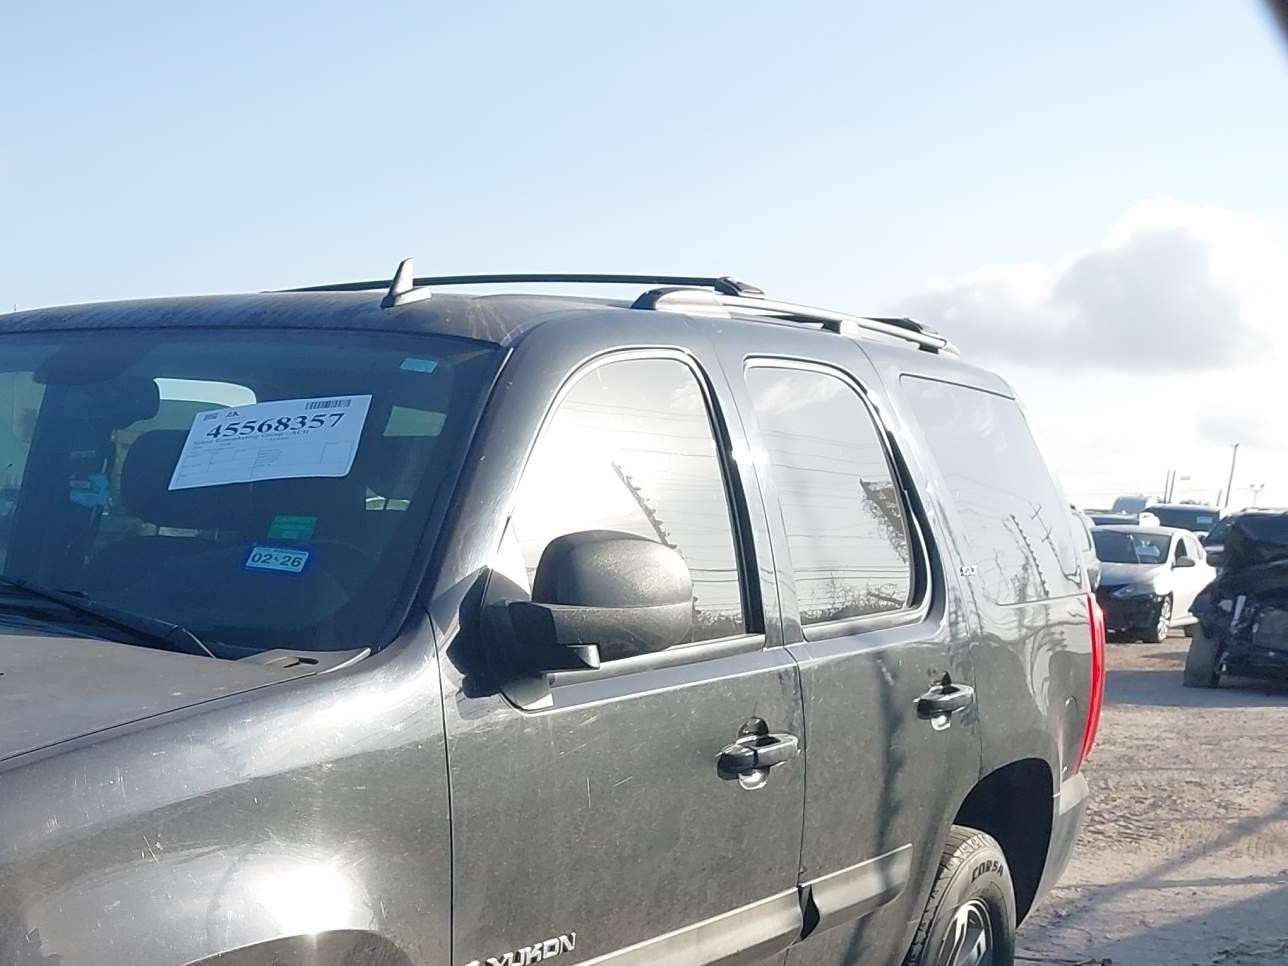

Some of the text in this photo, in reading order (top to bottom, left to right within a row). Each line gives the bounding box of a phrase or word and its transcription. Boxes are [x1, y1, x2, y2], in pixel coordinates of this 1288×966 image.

[206, 413, 345, 439] 45568357
[251, 552, 304, 568] 02 26
[971, 859, 1005, 884] CORSA
